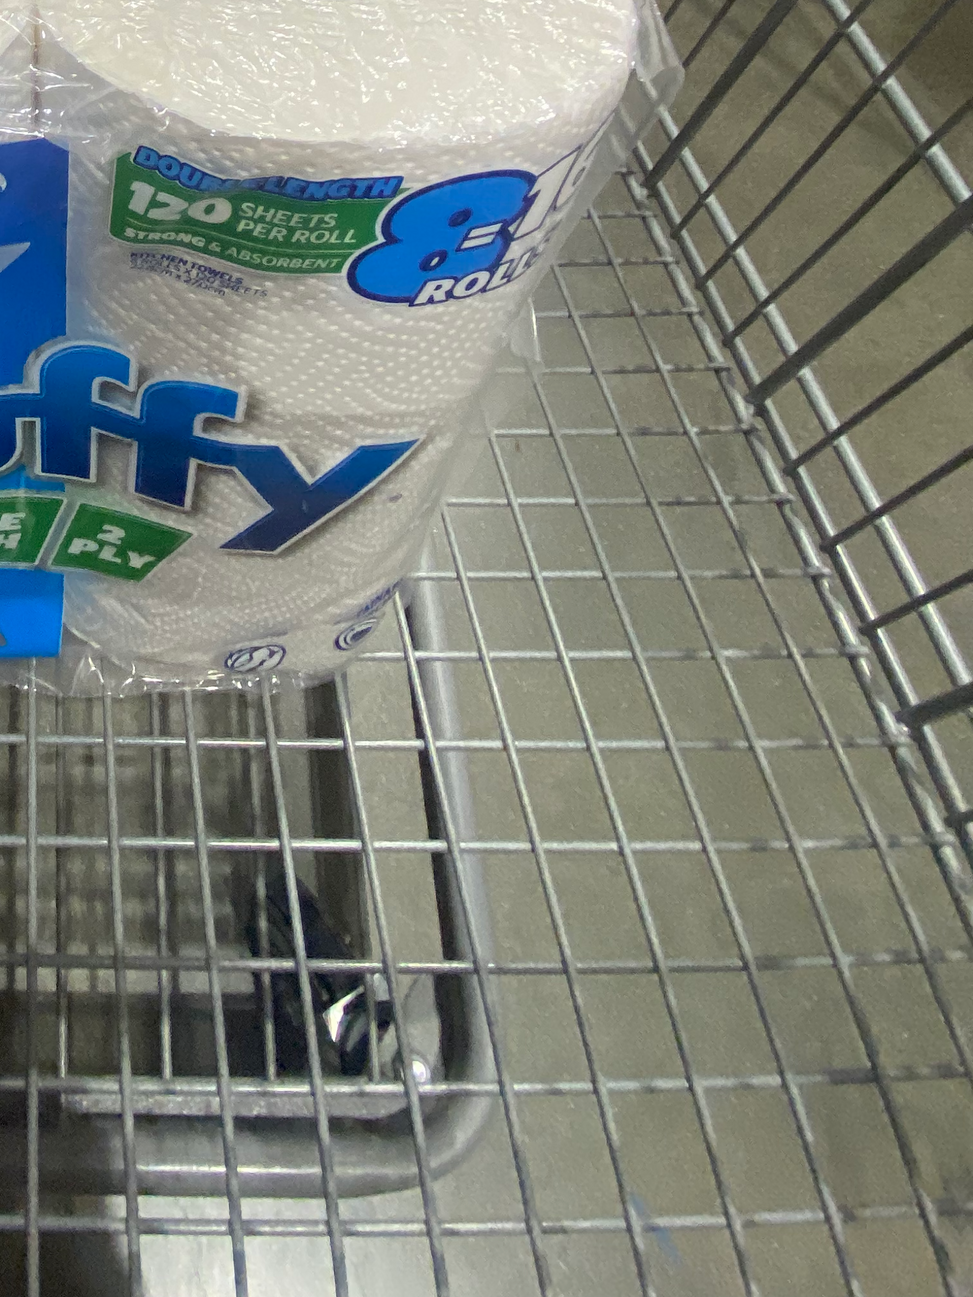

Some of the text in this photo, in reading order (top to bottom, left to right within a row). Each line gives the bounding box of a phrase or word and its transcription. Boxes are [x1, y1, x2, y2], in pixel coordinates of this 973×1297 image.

[133, 145, 283, 194] DOUB
[128, 181, 338, 228] 120 SHEETS
[236, 219, 357, 244] PER ROLL
[124, 228, 343, 269] STRONG & ABSORBENT
[191, 262, 244, 285] TOWELS
[97, 524, 125, 545] 2
[68, 537, 157, 570] PLY
